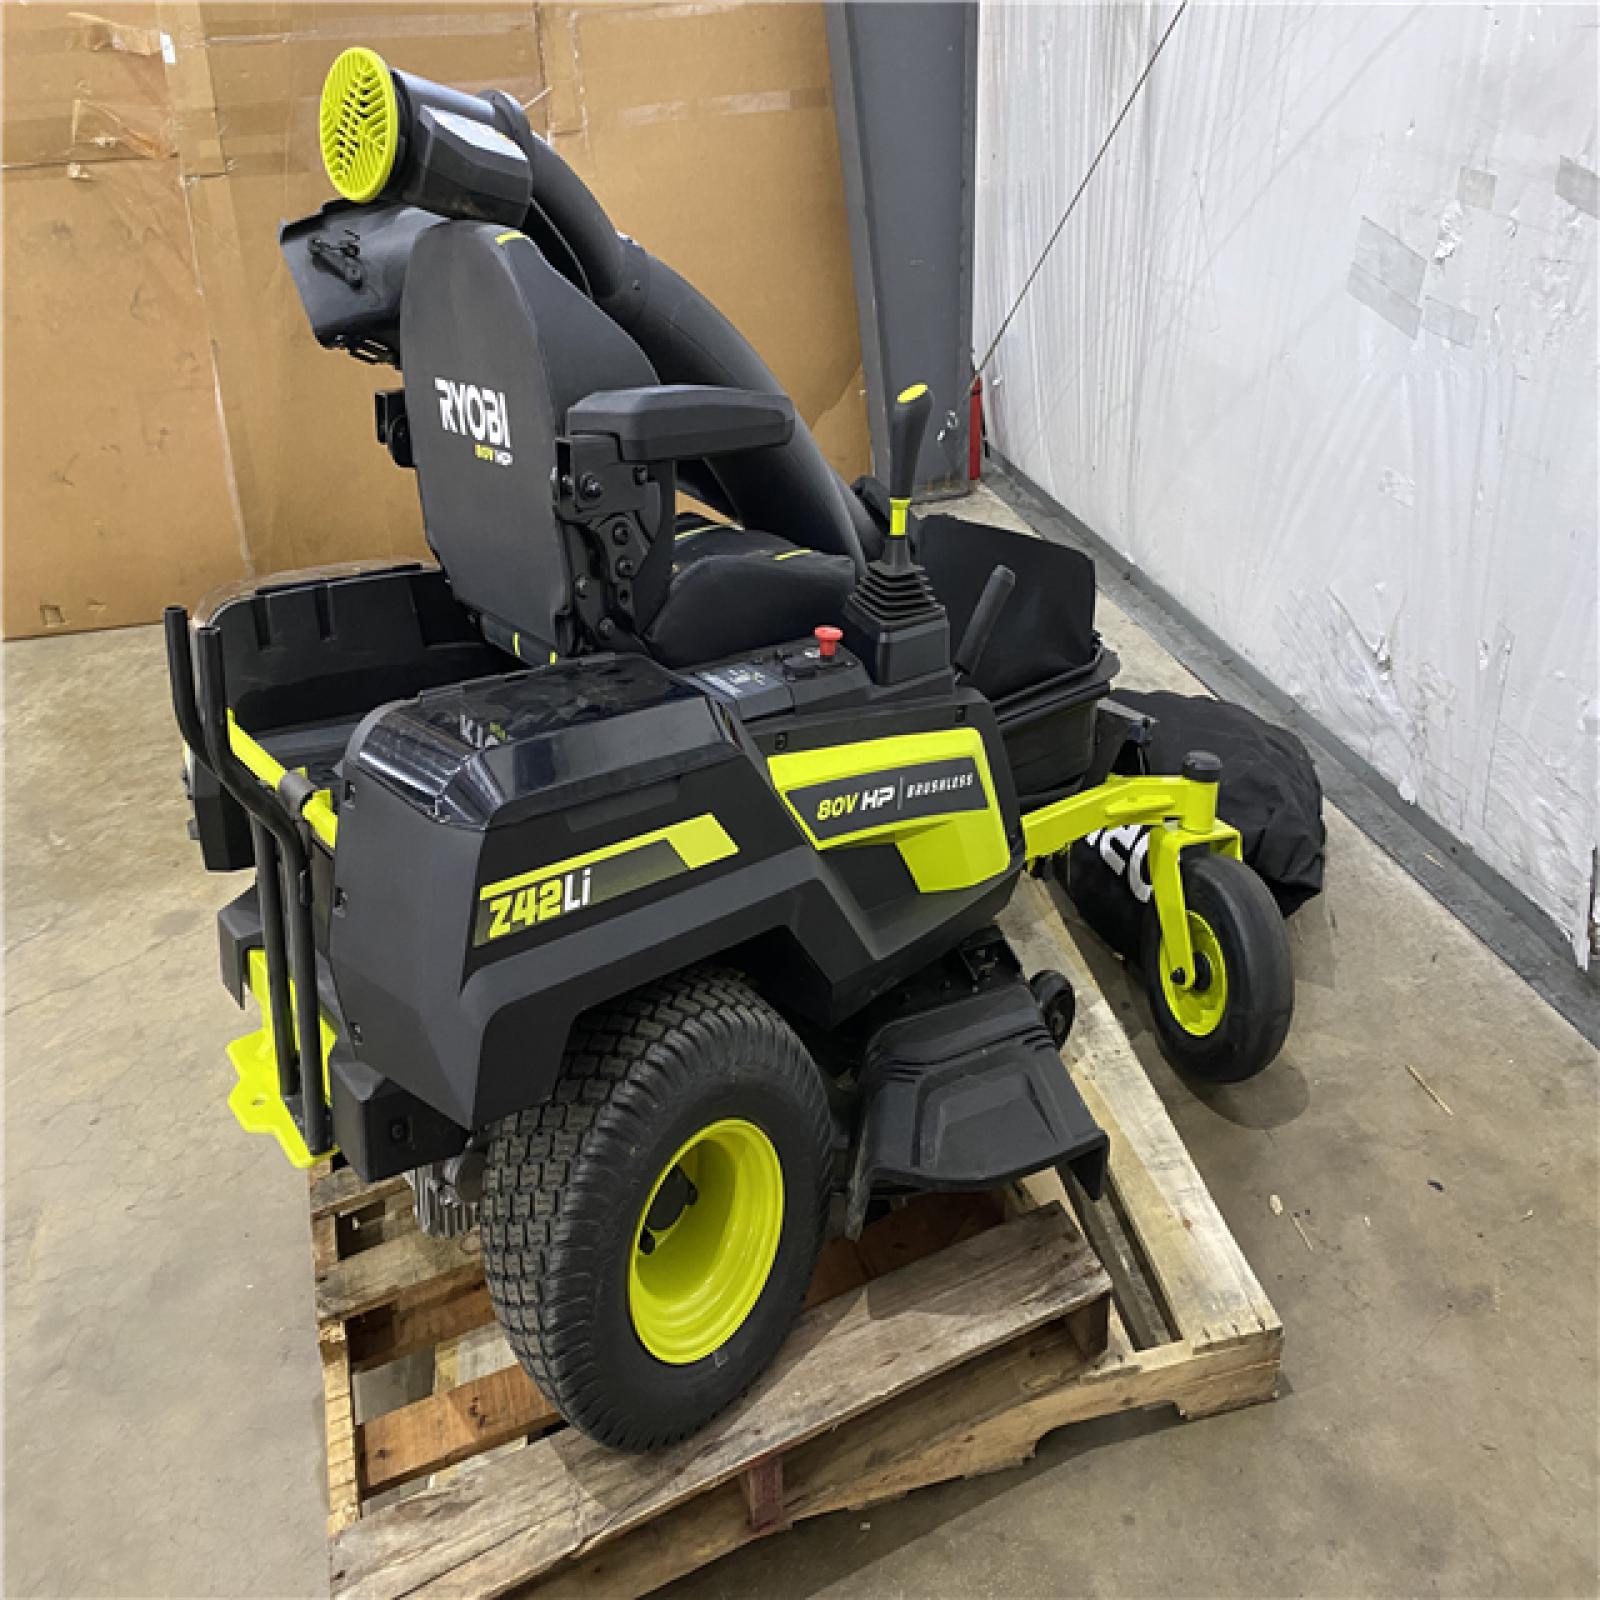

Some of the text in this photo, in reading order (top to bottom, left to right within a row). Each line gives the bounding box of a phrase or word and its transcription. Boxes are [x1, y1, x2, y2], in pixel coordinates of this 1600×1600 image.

[434, 377, 511, 448] RYOBI
[816, 772, 974, 821] 80V HP BRUSHLESS
[489, 866, 592, 939] Z42Li
